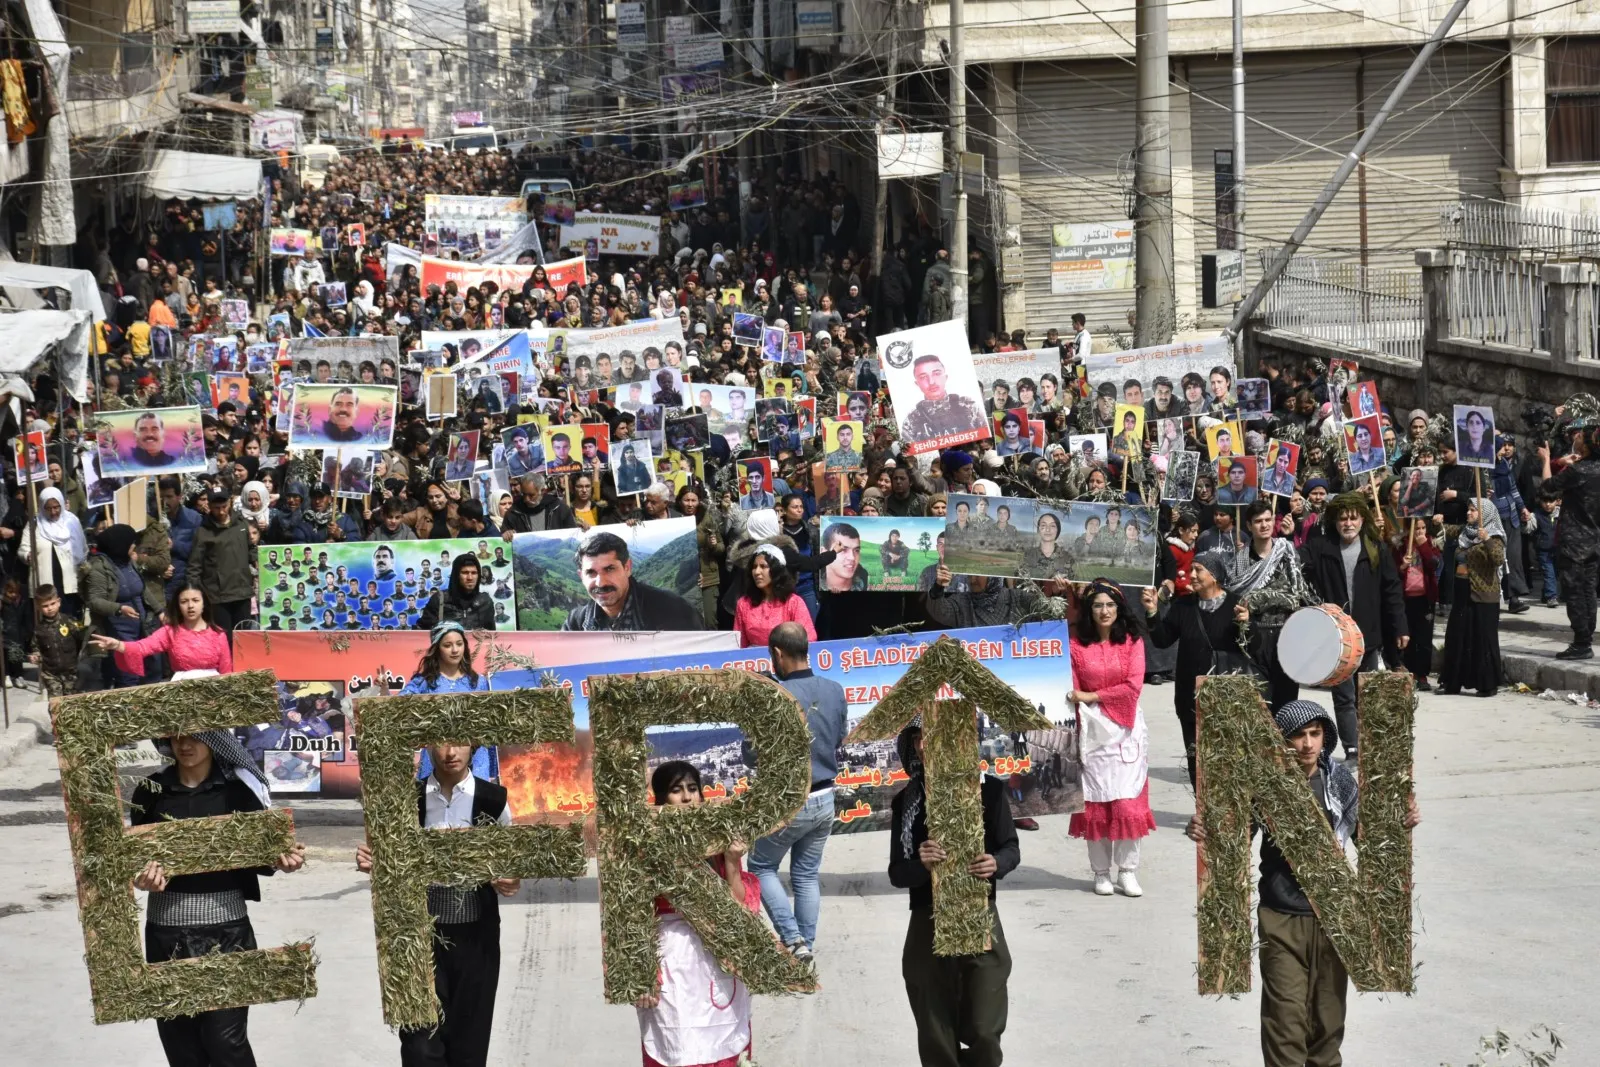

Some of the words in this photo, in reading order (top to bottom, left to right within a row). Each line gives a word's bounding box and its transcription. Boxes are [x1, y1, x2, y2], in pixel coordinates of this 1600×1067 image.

[601, 227, 619, 236] NA
[1082, 229, 1112, 243] الدكتور
[938, 430, 979, 446] ZAREDEŞT
[818, 649, 832, 670] Û
[348, 670, 405, 694] عفين
[289, 735, 341, 752] Duh
